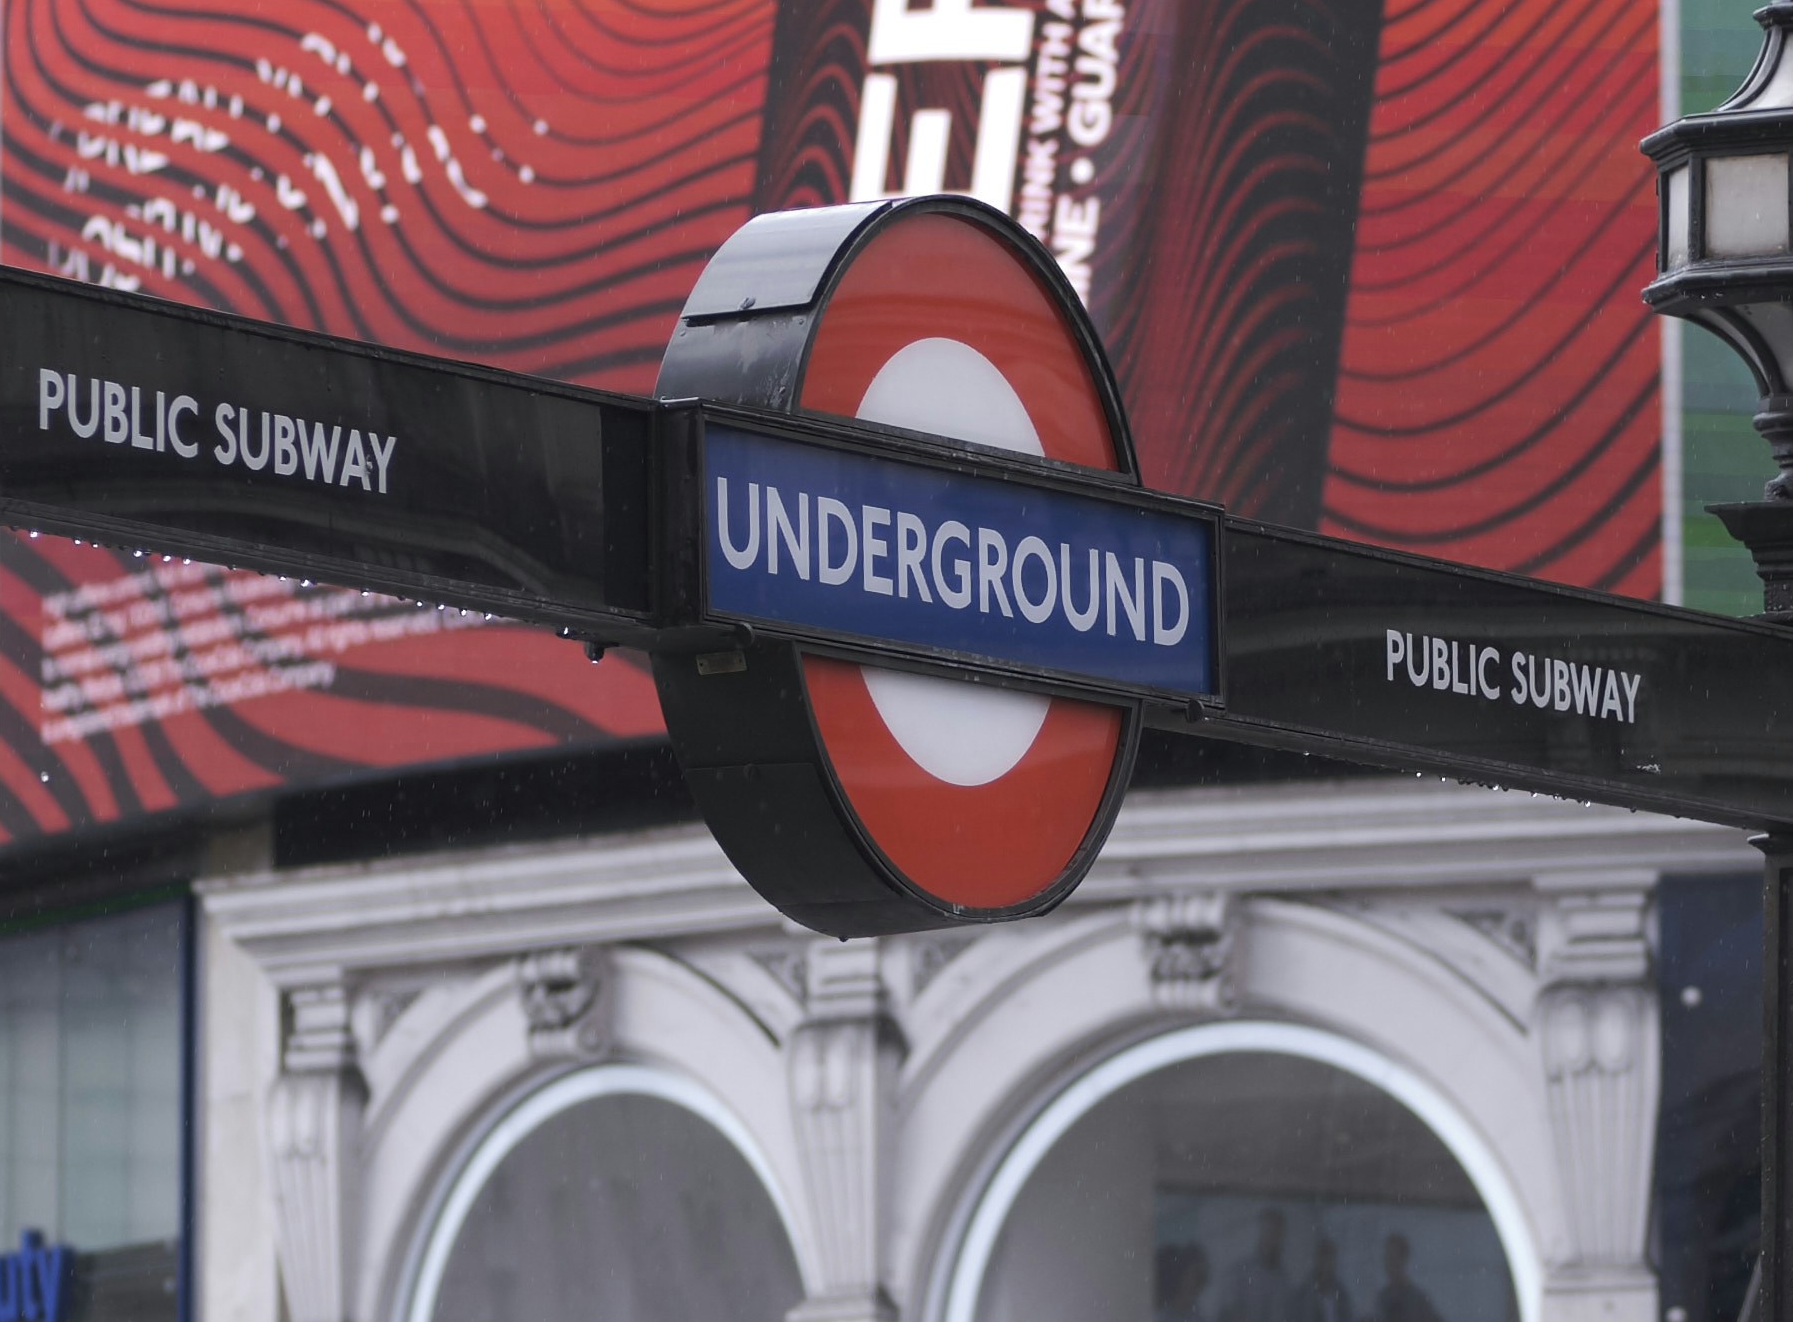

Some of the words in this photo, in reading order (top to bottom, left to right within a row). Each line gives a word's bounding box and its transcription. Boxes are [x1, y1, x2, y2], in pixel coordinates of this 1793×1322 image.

[1030, 22, 1074, 135] WITH
[38, 368, 199, 458] PUBLIC
[214, 402, 397, 495] SUBWAY
[715, 475, 1191, 648] UNDERGROUND
[1386, 628, 1501, 700] PUBLIC
[1511, 652, 1642, 724] SUBWAY
